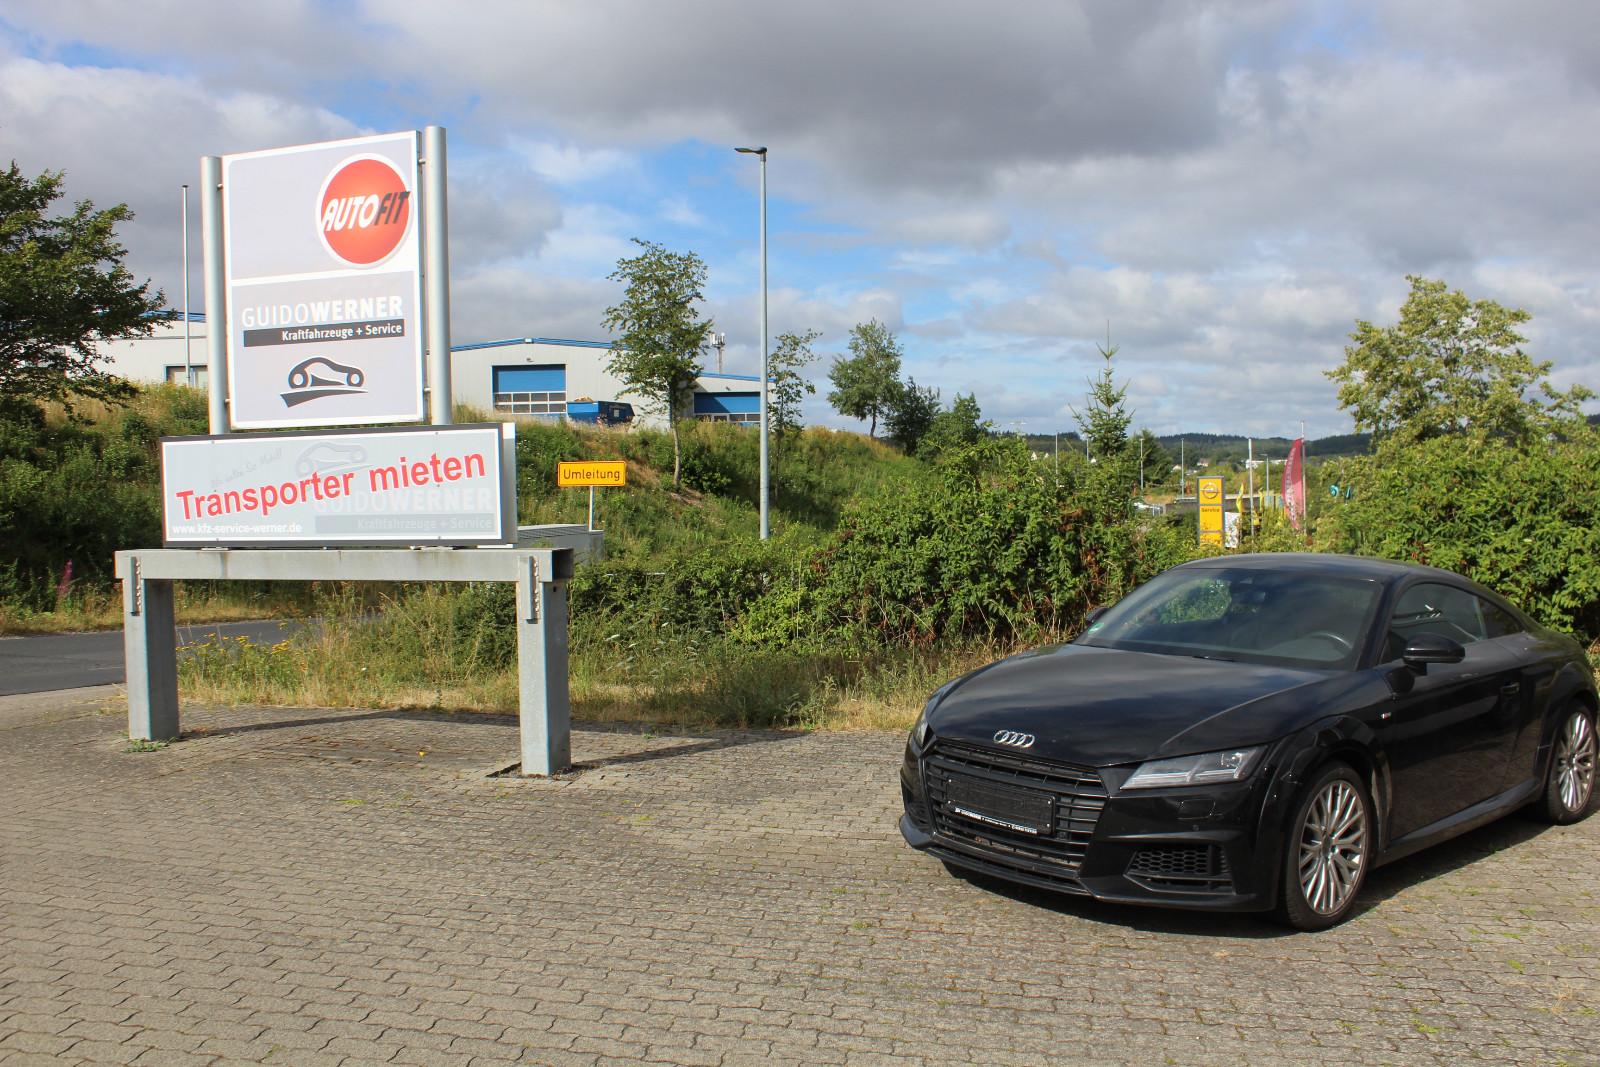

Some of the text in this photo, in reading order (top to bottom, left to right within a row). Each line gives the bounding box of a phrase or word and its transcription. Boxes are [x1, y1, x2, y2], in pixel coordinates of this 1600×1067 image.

[321, 191, 410, 231] AUTOFIT
[241, 296, 403, 327] GUIDOWERNER
[282, 323, 402, 341] Kraftfahrzeuge + Service
[563, 468, 620, 482] Umleitung
[176, 452, 486, 520] Transporter mieten
[172, 522, 303, 535] www.kfz-service-werner.de
[450, 516, 493, 529] Service
